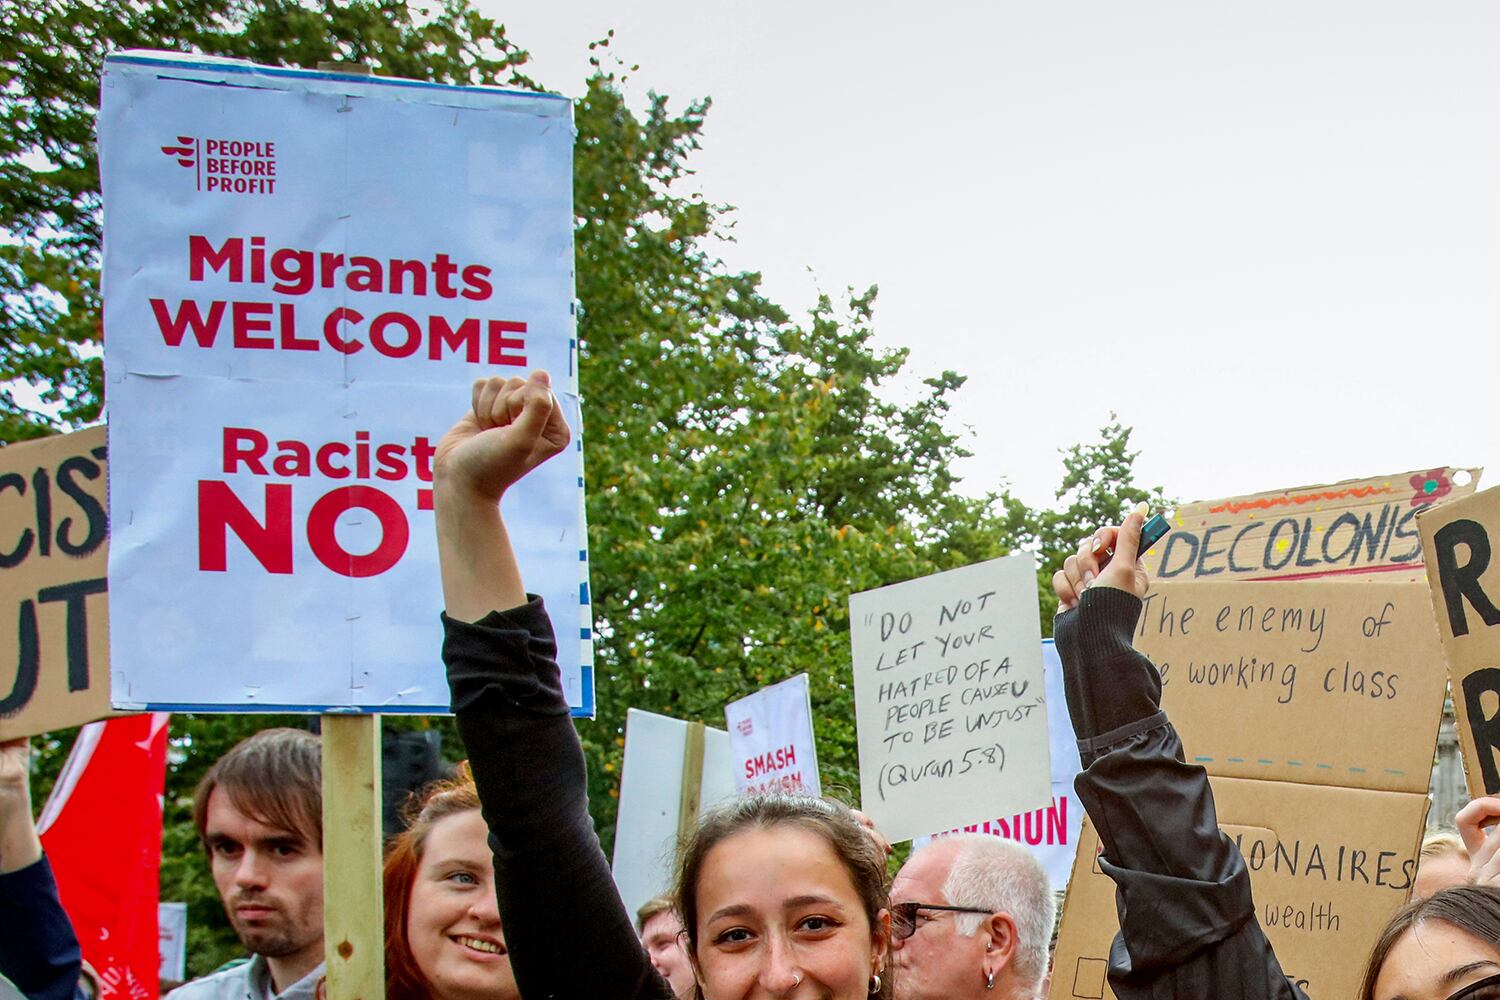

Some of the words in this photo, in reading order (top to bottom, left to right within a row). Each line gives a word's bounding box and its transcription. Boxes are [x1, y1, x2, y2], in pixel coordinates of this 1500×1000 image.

[206, 139, 275, 158] PEOPLE
[206, 158, 276, 176] BEFORE
[207, 176, 276, 194] PROFIT
[189, 235, 493, 301] Migrants
[149, 298, 527, 367] WELCOME
[938, 591, 997, 626] NOT
[1139, 592, 1196, 638] The
[1215, 603, 1326, 653] enemy
[1361, 602, 1395, 638] of
[876, 641, 926, 672] LET
[934, 624, 996, 658] YOUR
[878, 664, 958, 704] HATRED
[963, 658, 992, 682] OF
[993, 656, 1013, 679] A
[1188, 655, 1297, 705] working
[1322, 661, 1400, 701] class
[884, 692, 952, 731] PEOPLE
[883, 731, 914, 753] TO
[923, 718, 955, 744] BE
[745, 744, 796, 780] SMASH
[1264, 901, 1341, 932] wealth
